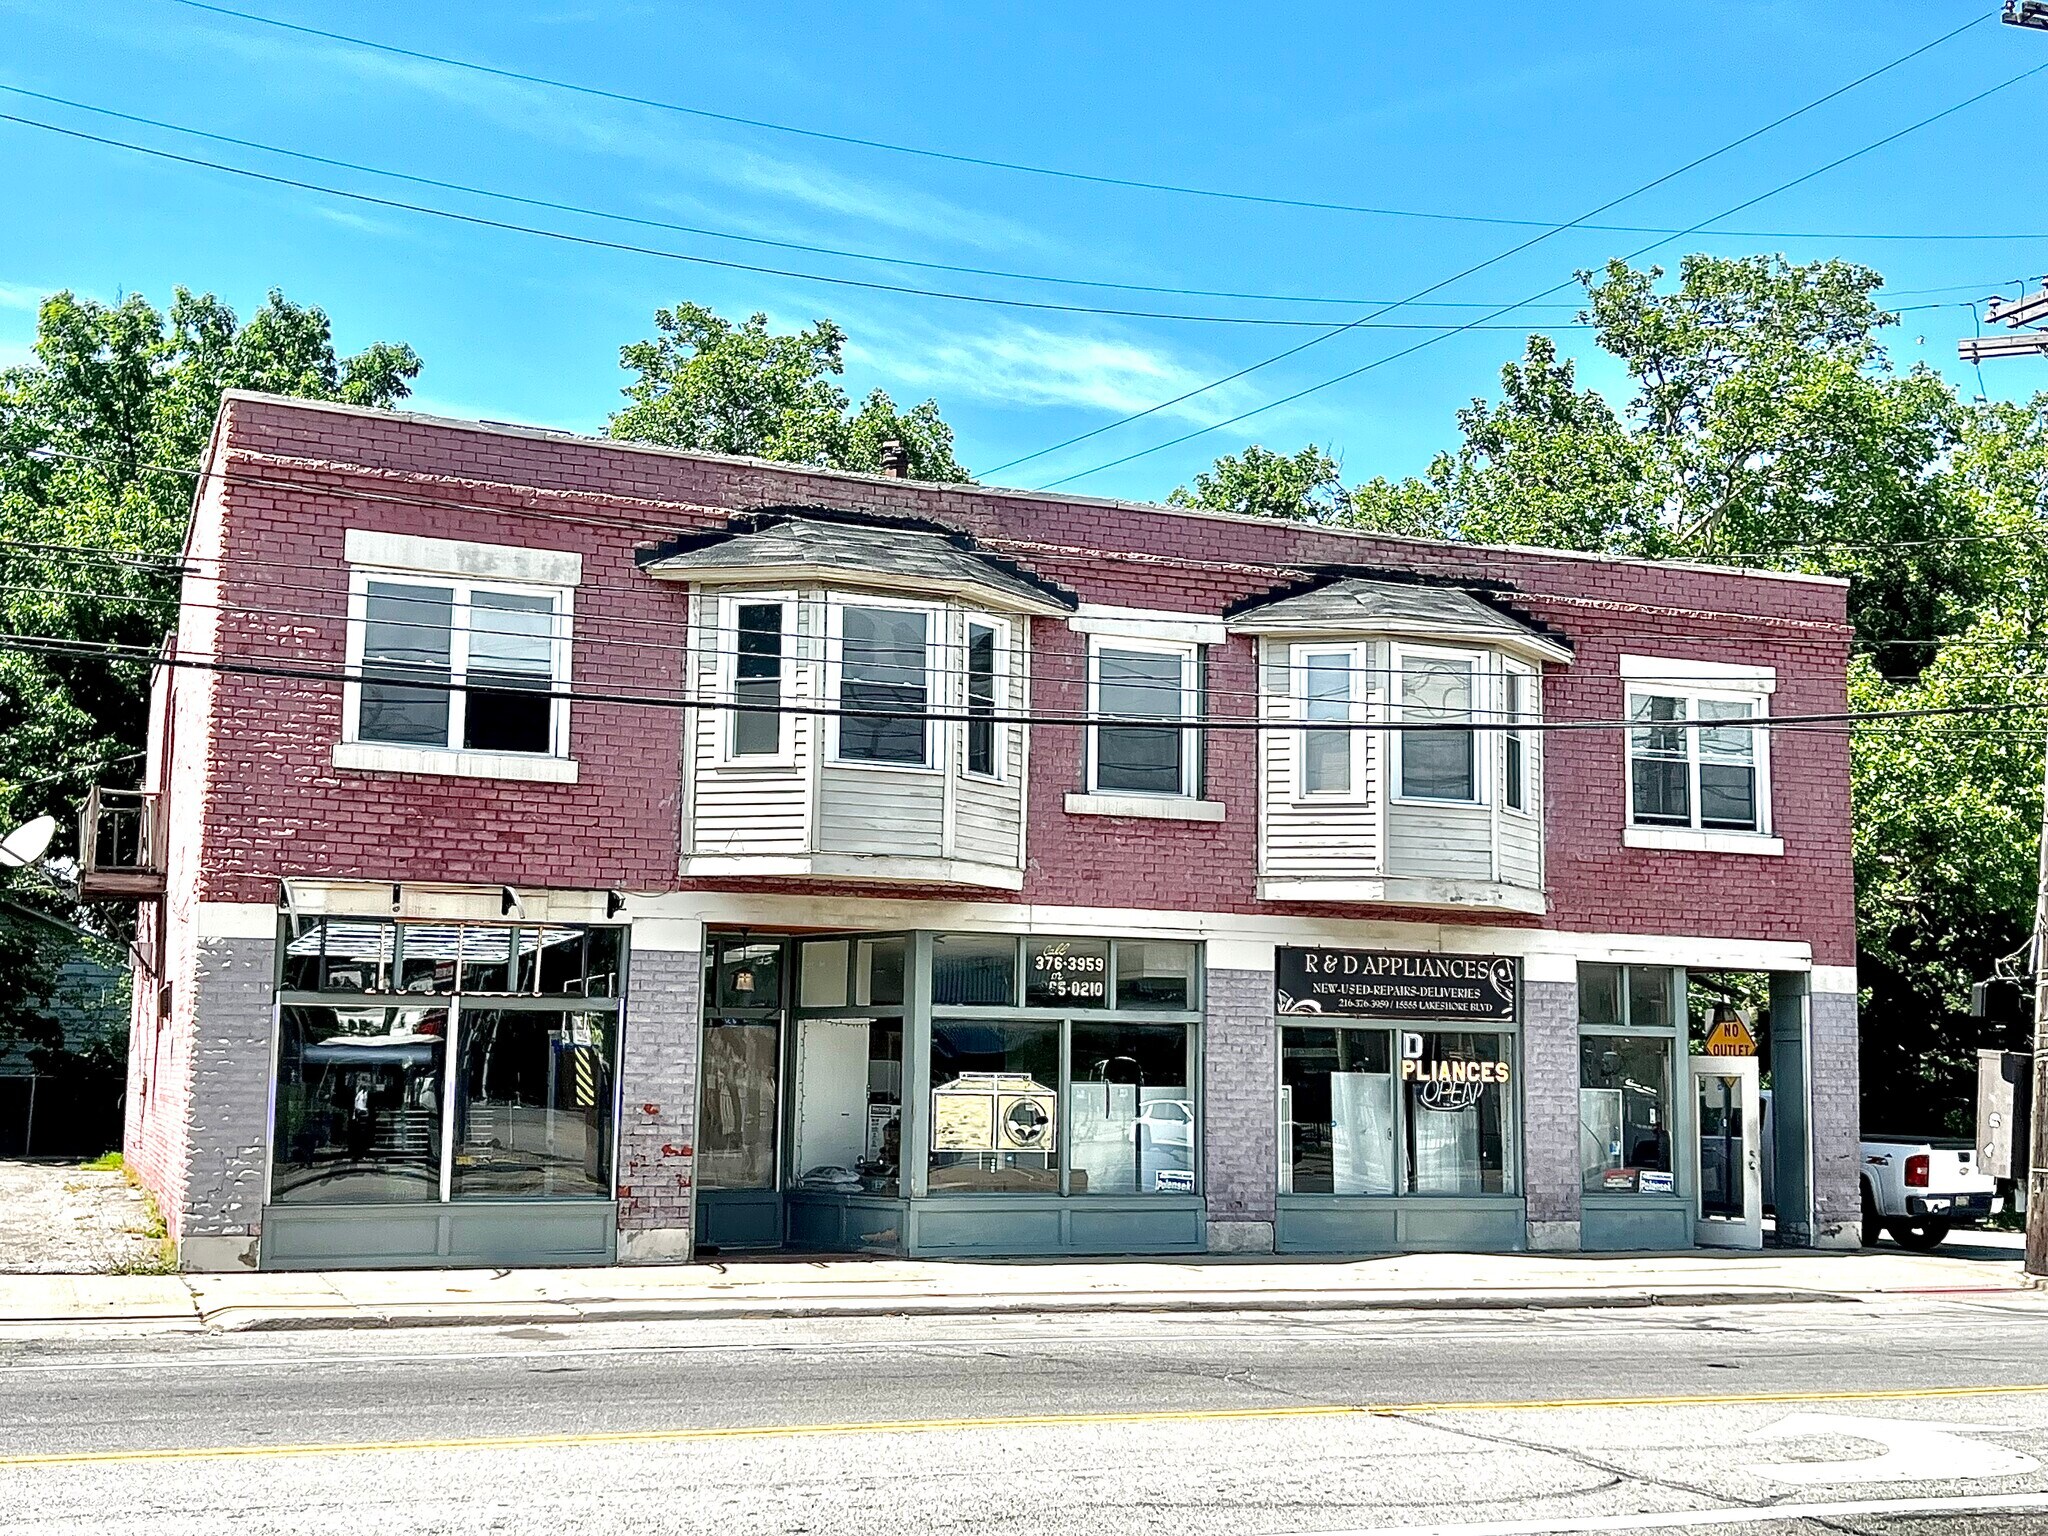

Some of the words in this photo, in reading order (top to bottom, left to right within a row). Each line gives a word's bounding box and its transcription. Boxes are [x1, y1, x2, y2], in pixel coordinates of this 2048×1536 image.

[1043, 942, 1070, 956] Call
[1305, 953, 1319, 973] R
[1324, 954, 1338, 974] &
[1343, 955, 1358, 975] D
[1363, 956, 1489, 979] APPLIANCES
[1051, 971, 1064, 980] or
[1312, 982, 1481, 999] NEW-USED-REPAIRS-DELIVERIES
[1419, 1001, 1469, 1011] LAKESHORE
[1470, 1002, 1493, 1012] BLVD
[1724, 1023, 1739, 1037] NO
[1403, 1032, 1424, 1058] D
[1713, 1043, 1750, 1056] OUTLET
[1401, 1060, 1509, 1083] PLIANCES
[1423, 1079, 1480, 1105] OPEN
